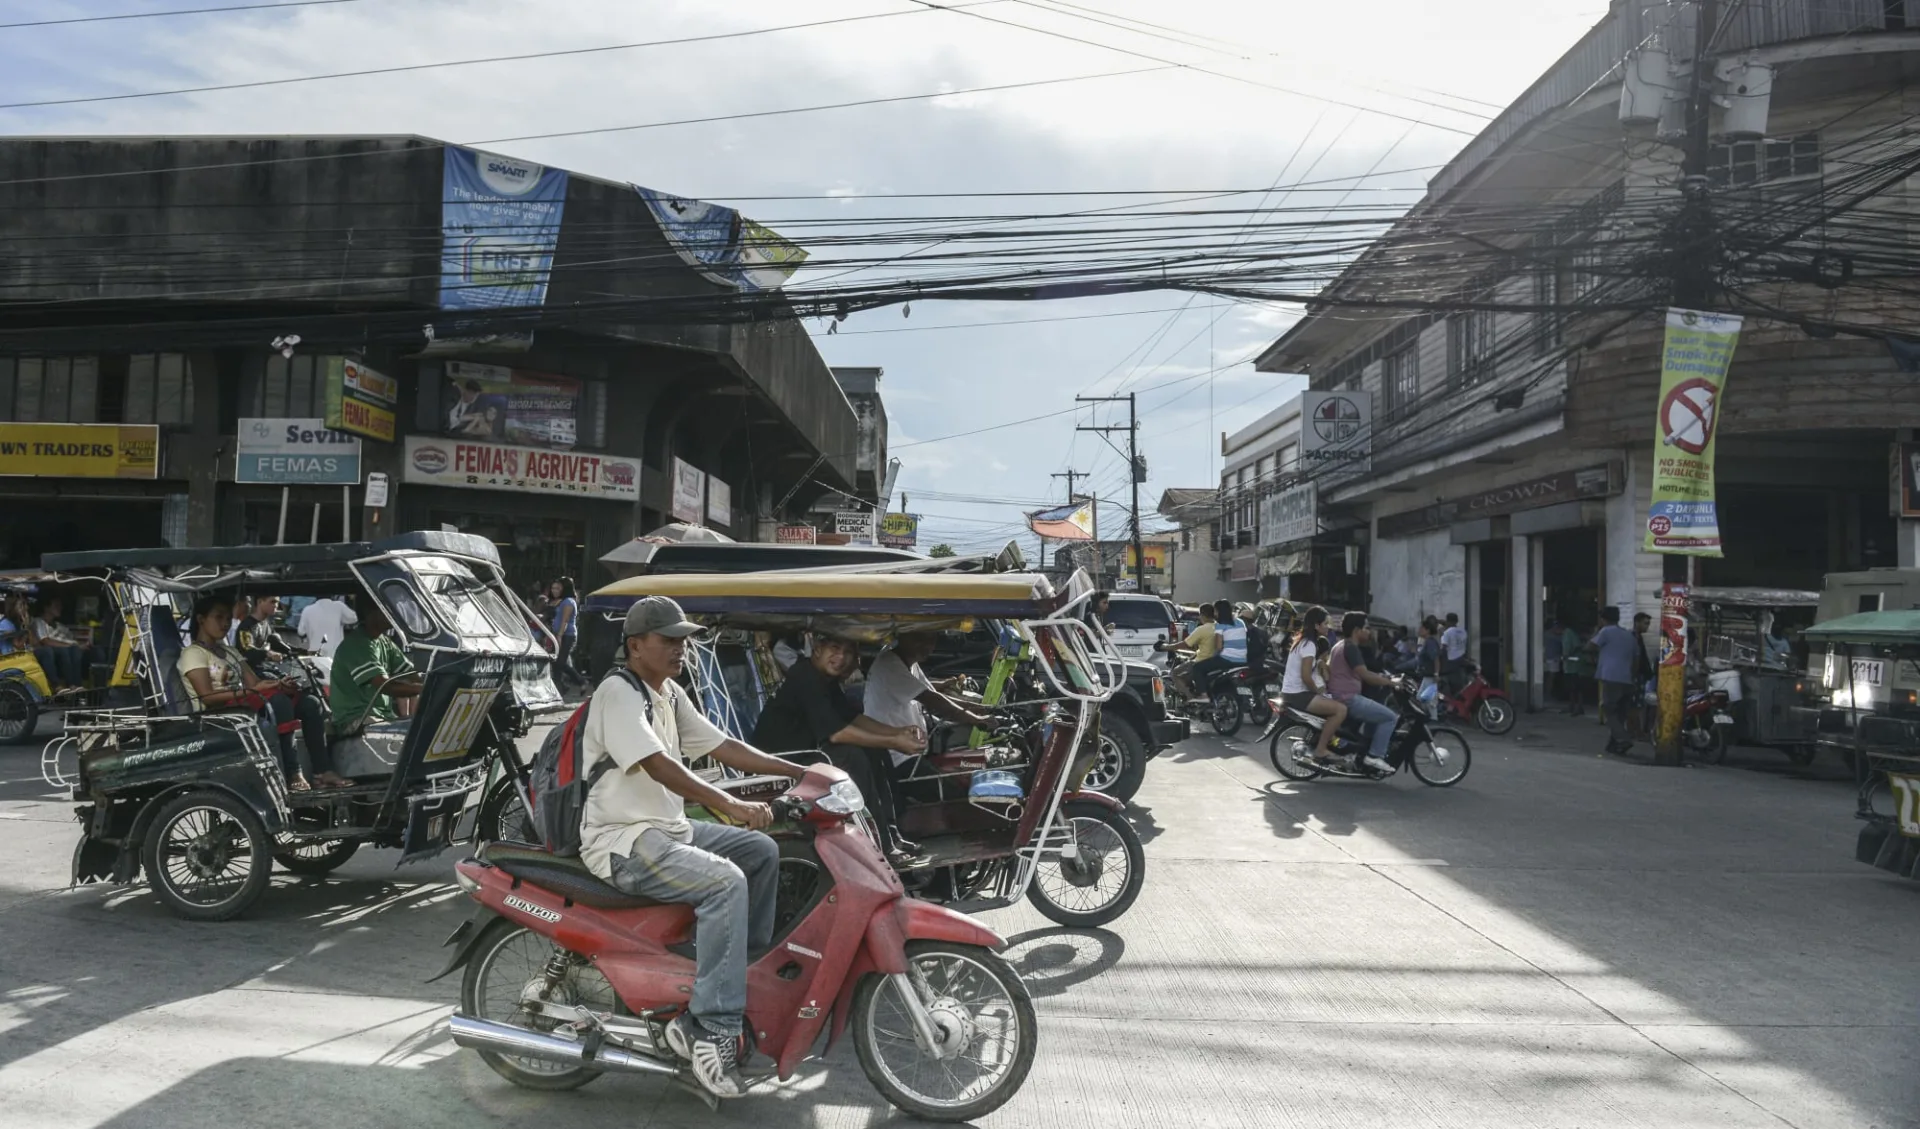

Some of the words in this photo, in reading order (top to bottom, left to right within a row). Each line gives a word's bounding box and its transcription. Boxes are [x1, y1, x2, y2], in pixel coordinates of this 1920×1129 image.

[488, 162, 528, 178] SMART
[453, 187, 471, 199] The
[523, 201, 555, 214] mobile
[493, 206, 519, 217] gives
[522, 210, 539, 219] you
[33, 442, 114, 458] TRADERS
[257, 457, 338, 473] FEMAS
[455, 444, 520, 478] FEMA'S
[526, 451, 601, 484] AGRIVET
[1469, 479, 1558, 510] CROWN
[837, 518, 871, 526] MEDICAL
[839, 525, 864, 533] CLINIC
[778, 528, 813, 539] SALLY'S
[505, 896, 561, 923] DUNLOP
